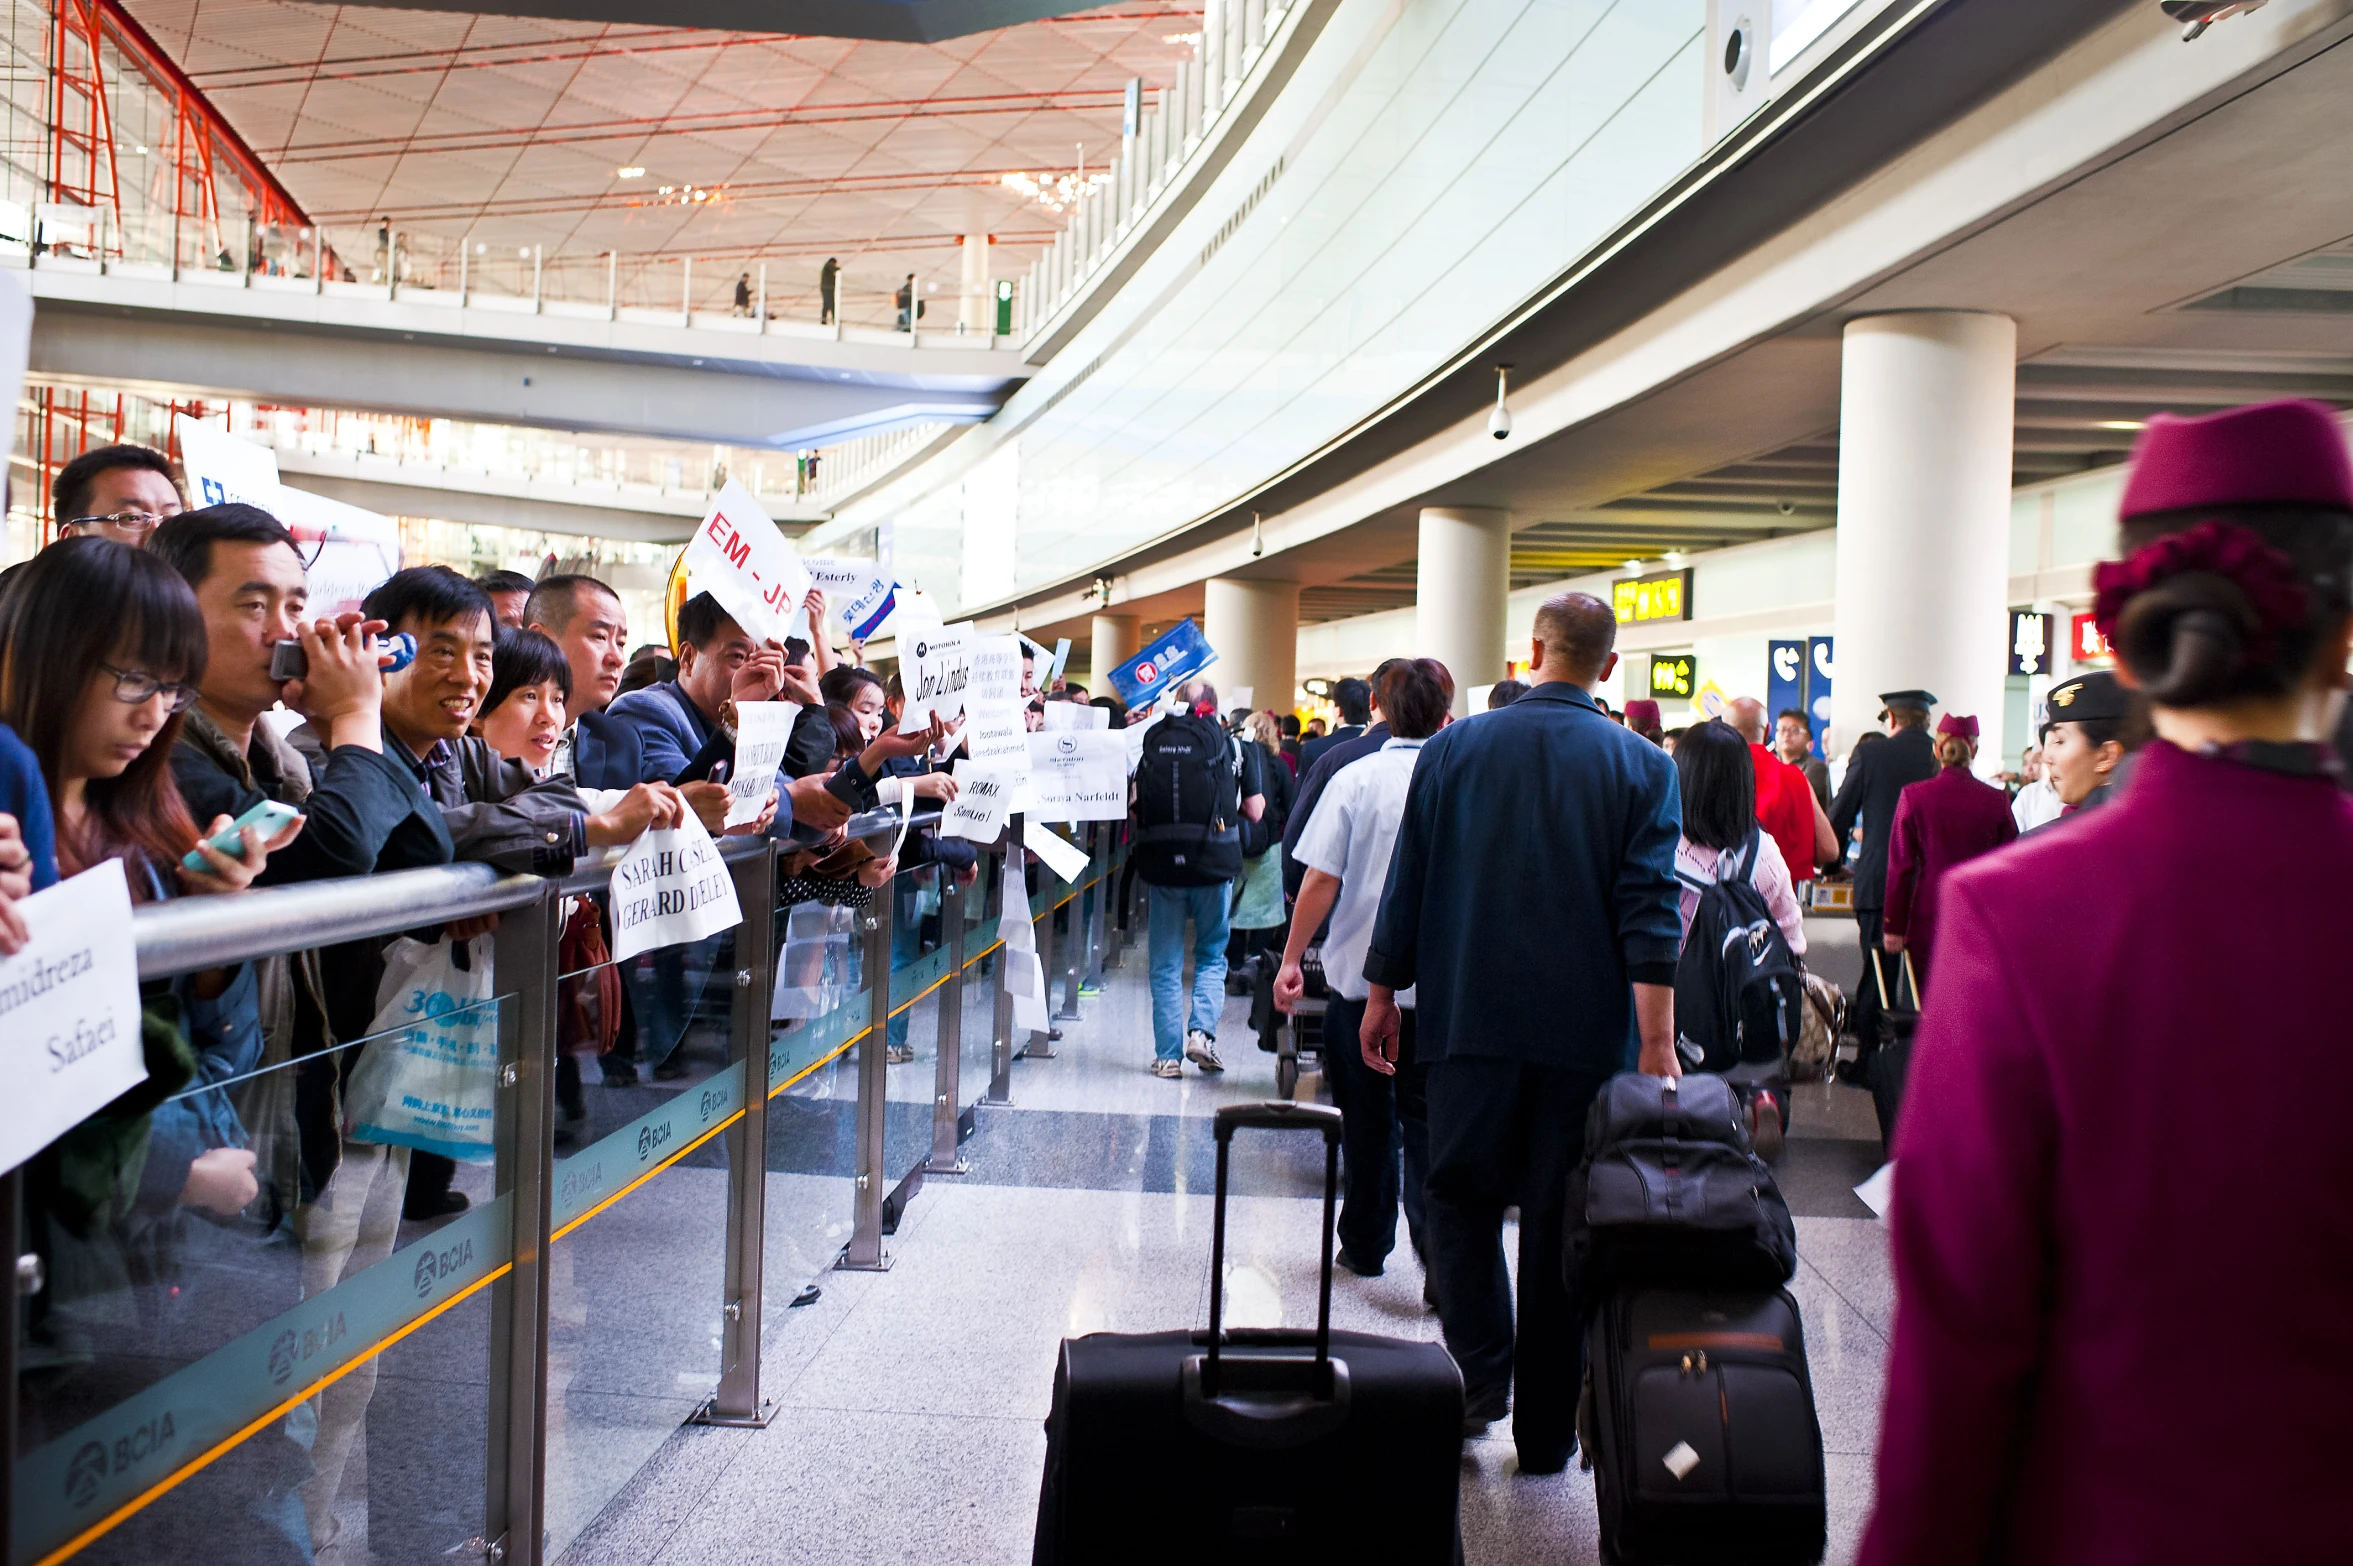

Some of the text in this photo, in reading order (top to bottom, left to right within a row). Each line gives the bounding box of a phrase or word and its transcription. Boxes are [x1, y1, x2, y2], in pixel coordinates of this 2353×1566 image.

[816, 571, 857, 584] Esterly
[1041, 791, 1119, 805] Soraya Narfeldt
[621, 850, 674, 891] SARAH
[623, 888, 685, 931] GERARD
[48, 1004, 116, 1074] Safaei
[711, 1087, 728, 1111] BCIA
[651, 1120, 672, 1149] BCIA
[578, 1161, 601, 1194] BCIA
[438, 1238, 474, 1280] BCIA
[113, 1411, 176, 1476] BCIA
